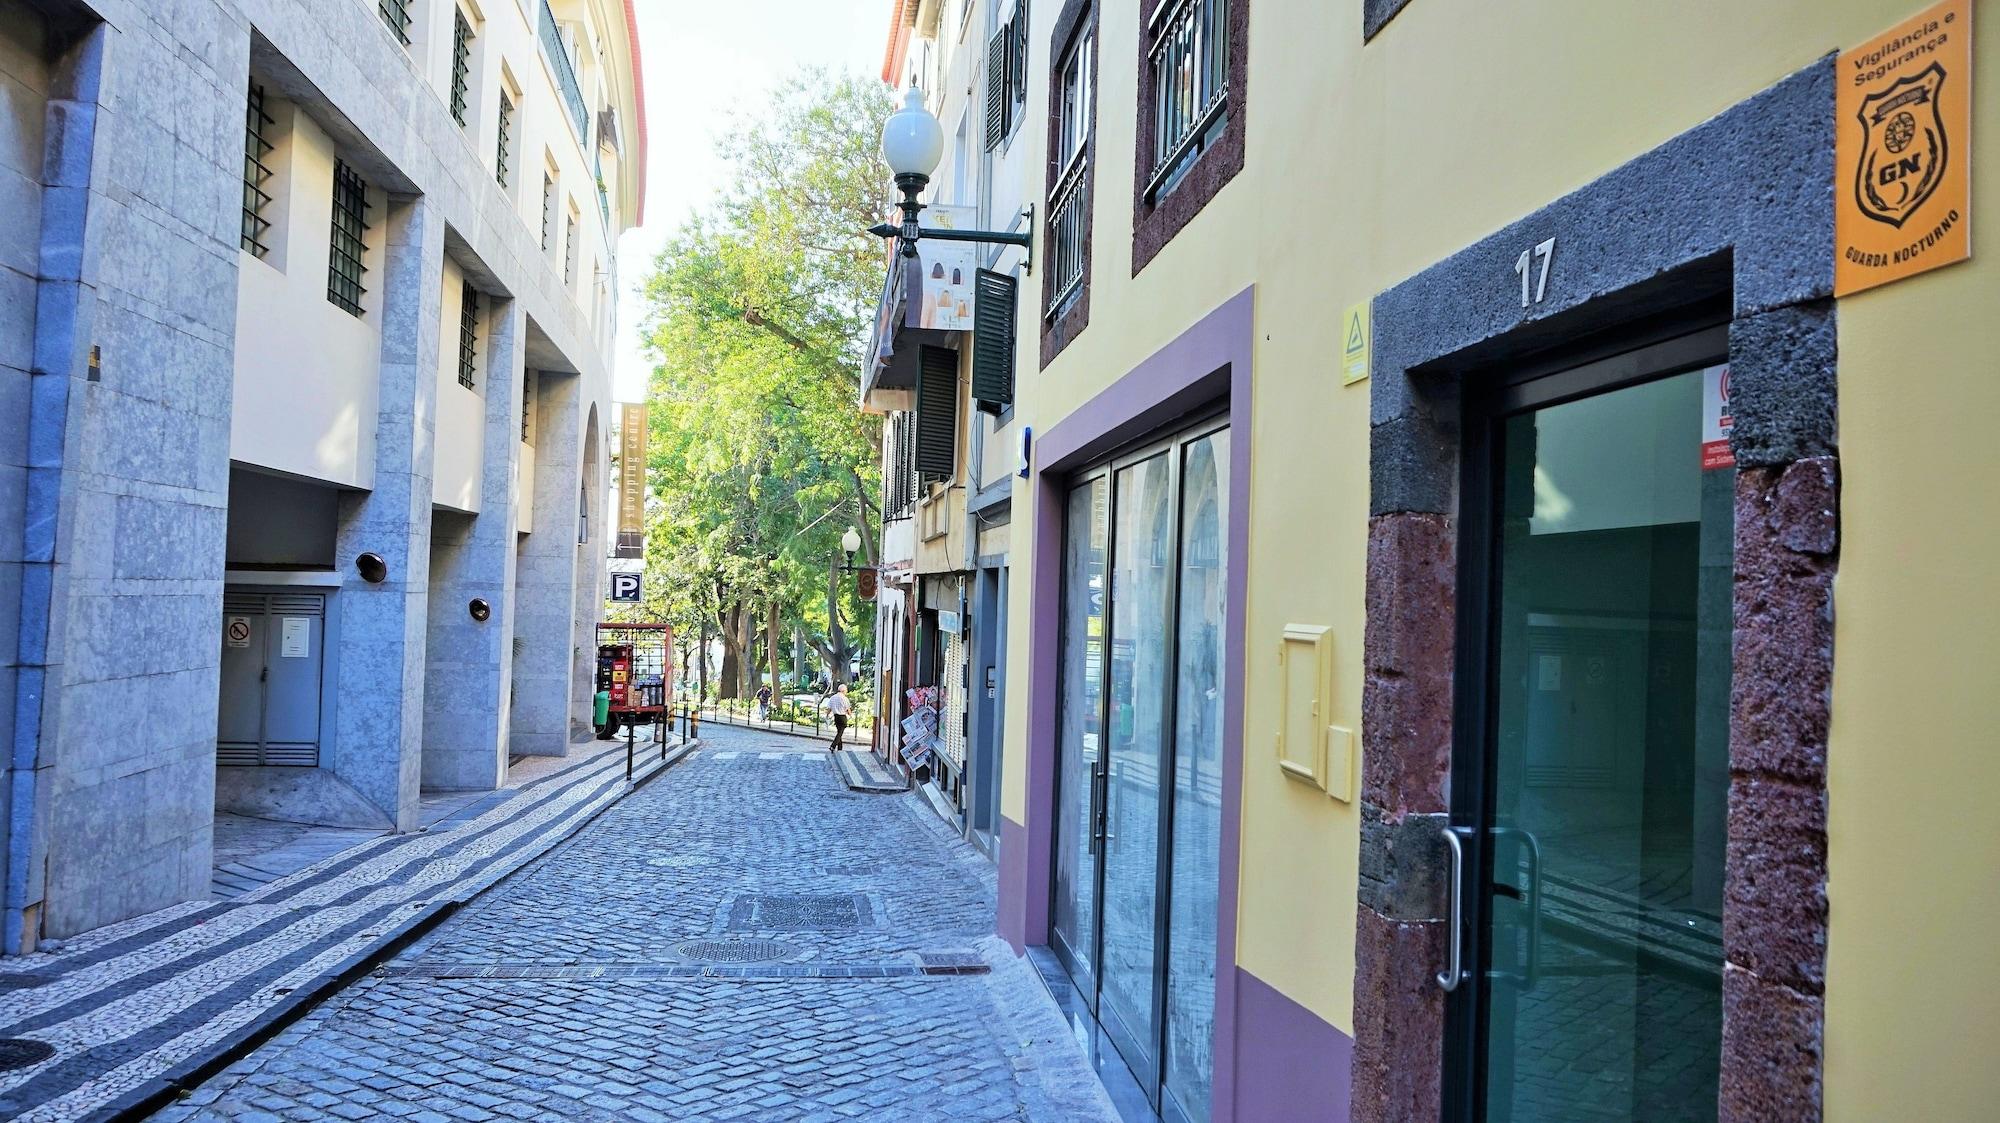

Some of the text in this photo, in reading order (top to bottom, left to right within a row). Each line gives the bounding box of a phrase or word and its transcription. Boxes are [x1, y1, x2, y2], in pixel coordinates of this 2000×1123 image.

[1854, 11, 1956, 70] Vigilância e
[1854, 33, 1948, 87] Segurança
[1878, 152, 1922, 187] GN
[1845, 208, 1960, 268] GUARDA NOCTURNO
[1514, 236, 1556, 308] 17
[628, 408, 640, 449] centre
[623, 457, 640, 518] shopping
[615, 577, 638, 598] P
